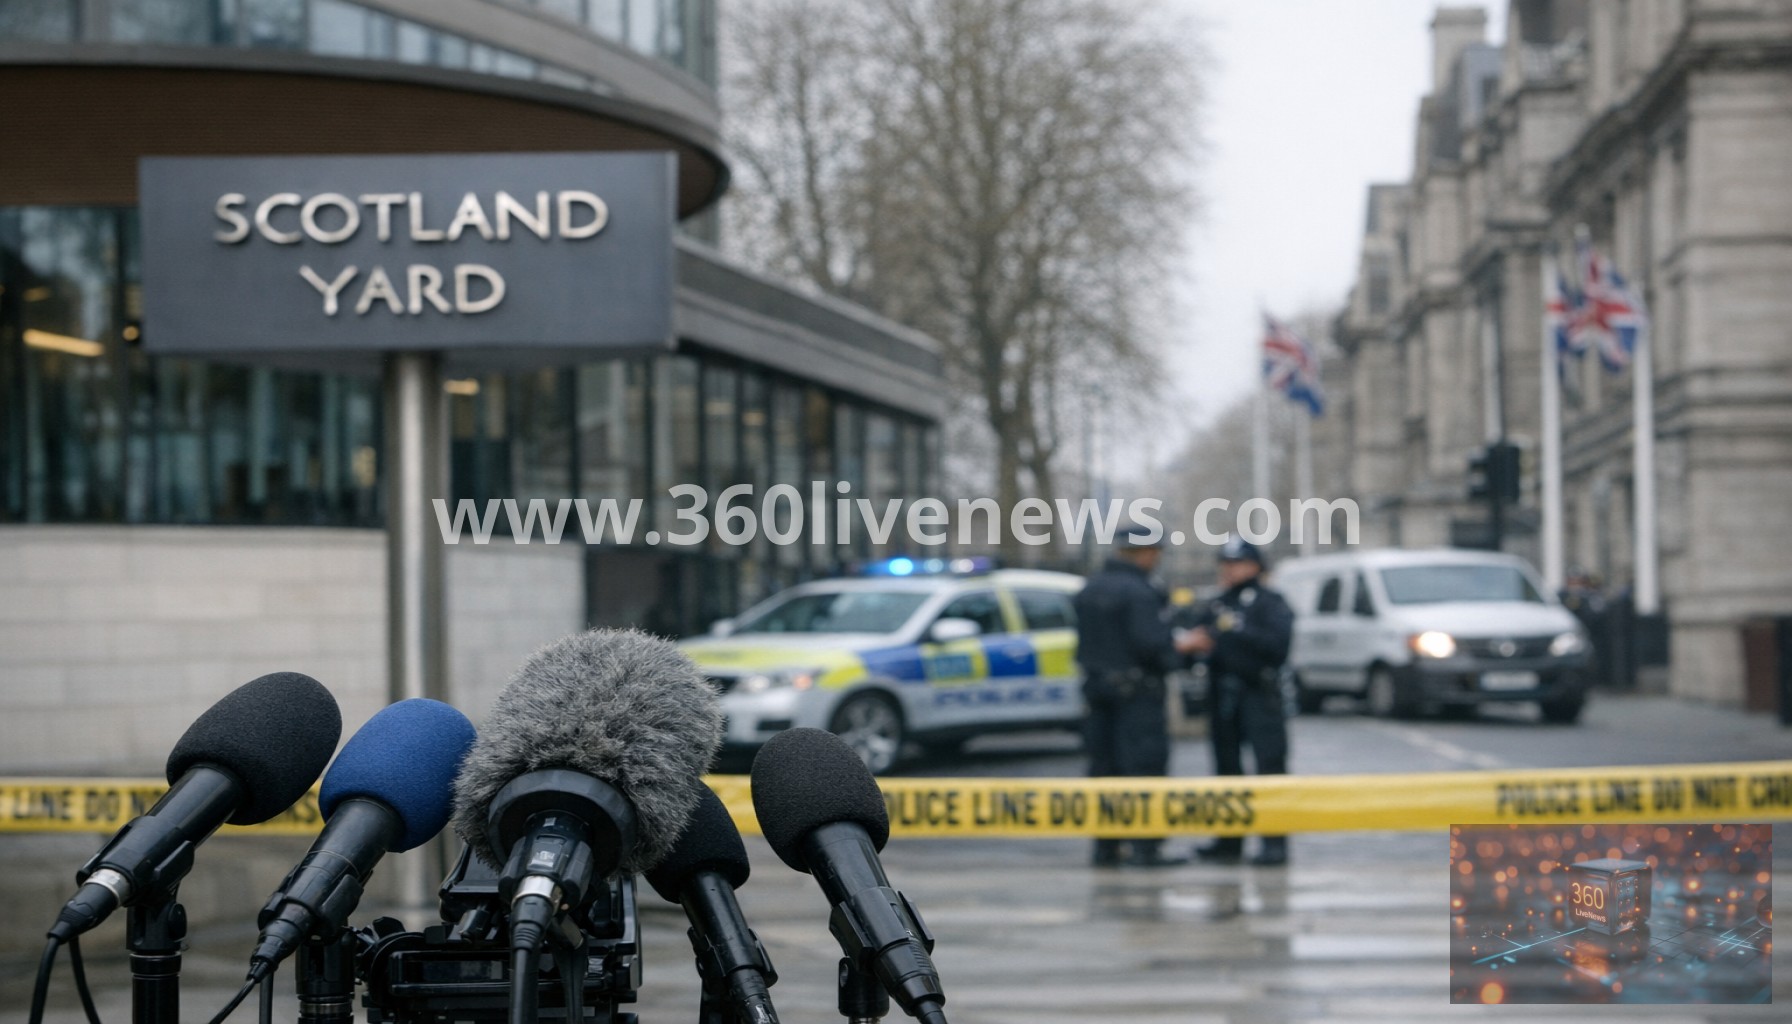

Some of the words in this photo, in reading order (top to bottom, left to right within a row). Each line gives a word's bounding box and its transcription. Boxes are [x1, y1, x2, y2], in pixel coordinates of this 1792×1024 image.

[213, 190, 609, 244] SCOTLAND
[299, 263, 506, 315] YARD
[86, 789, 120, 821] DO
[883, 791, 960, 826] OLICE
[972, 791, 1038, 826] LINE
[1051, 791, 1087, 826] DO
[1099, 791, 1152, 826] NOT
[1164, 790, 1256, 826] CROSS
[1496, 781, 1578, 816] POLICE
[1589, 778, 1643, 814] LINE
[1653, 777, 1684, 813] DO
[1692, 775, 1737, 809] NOT
[1748, 773, 1792, 809] CRO
